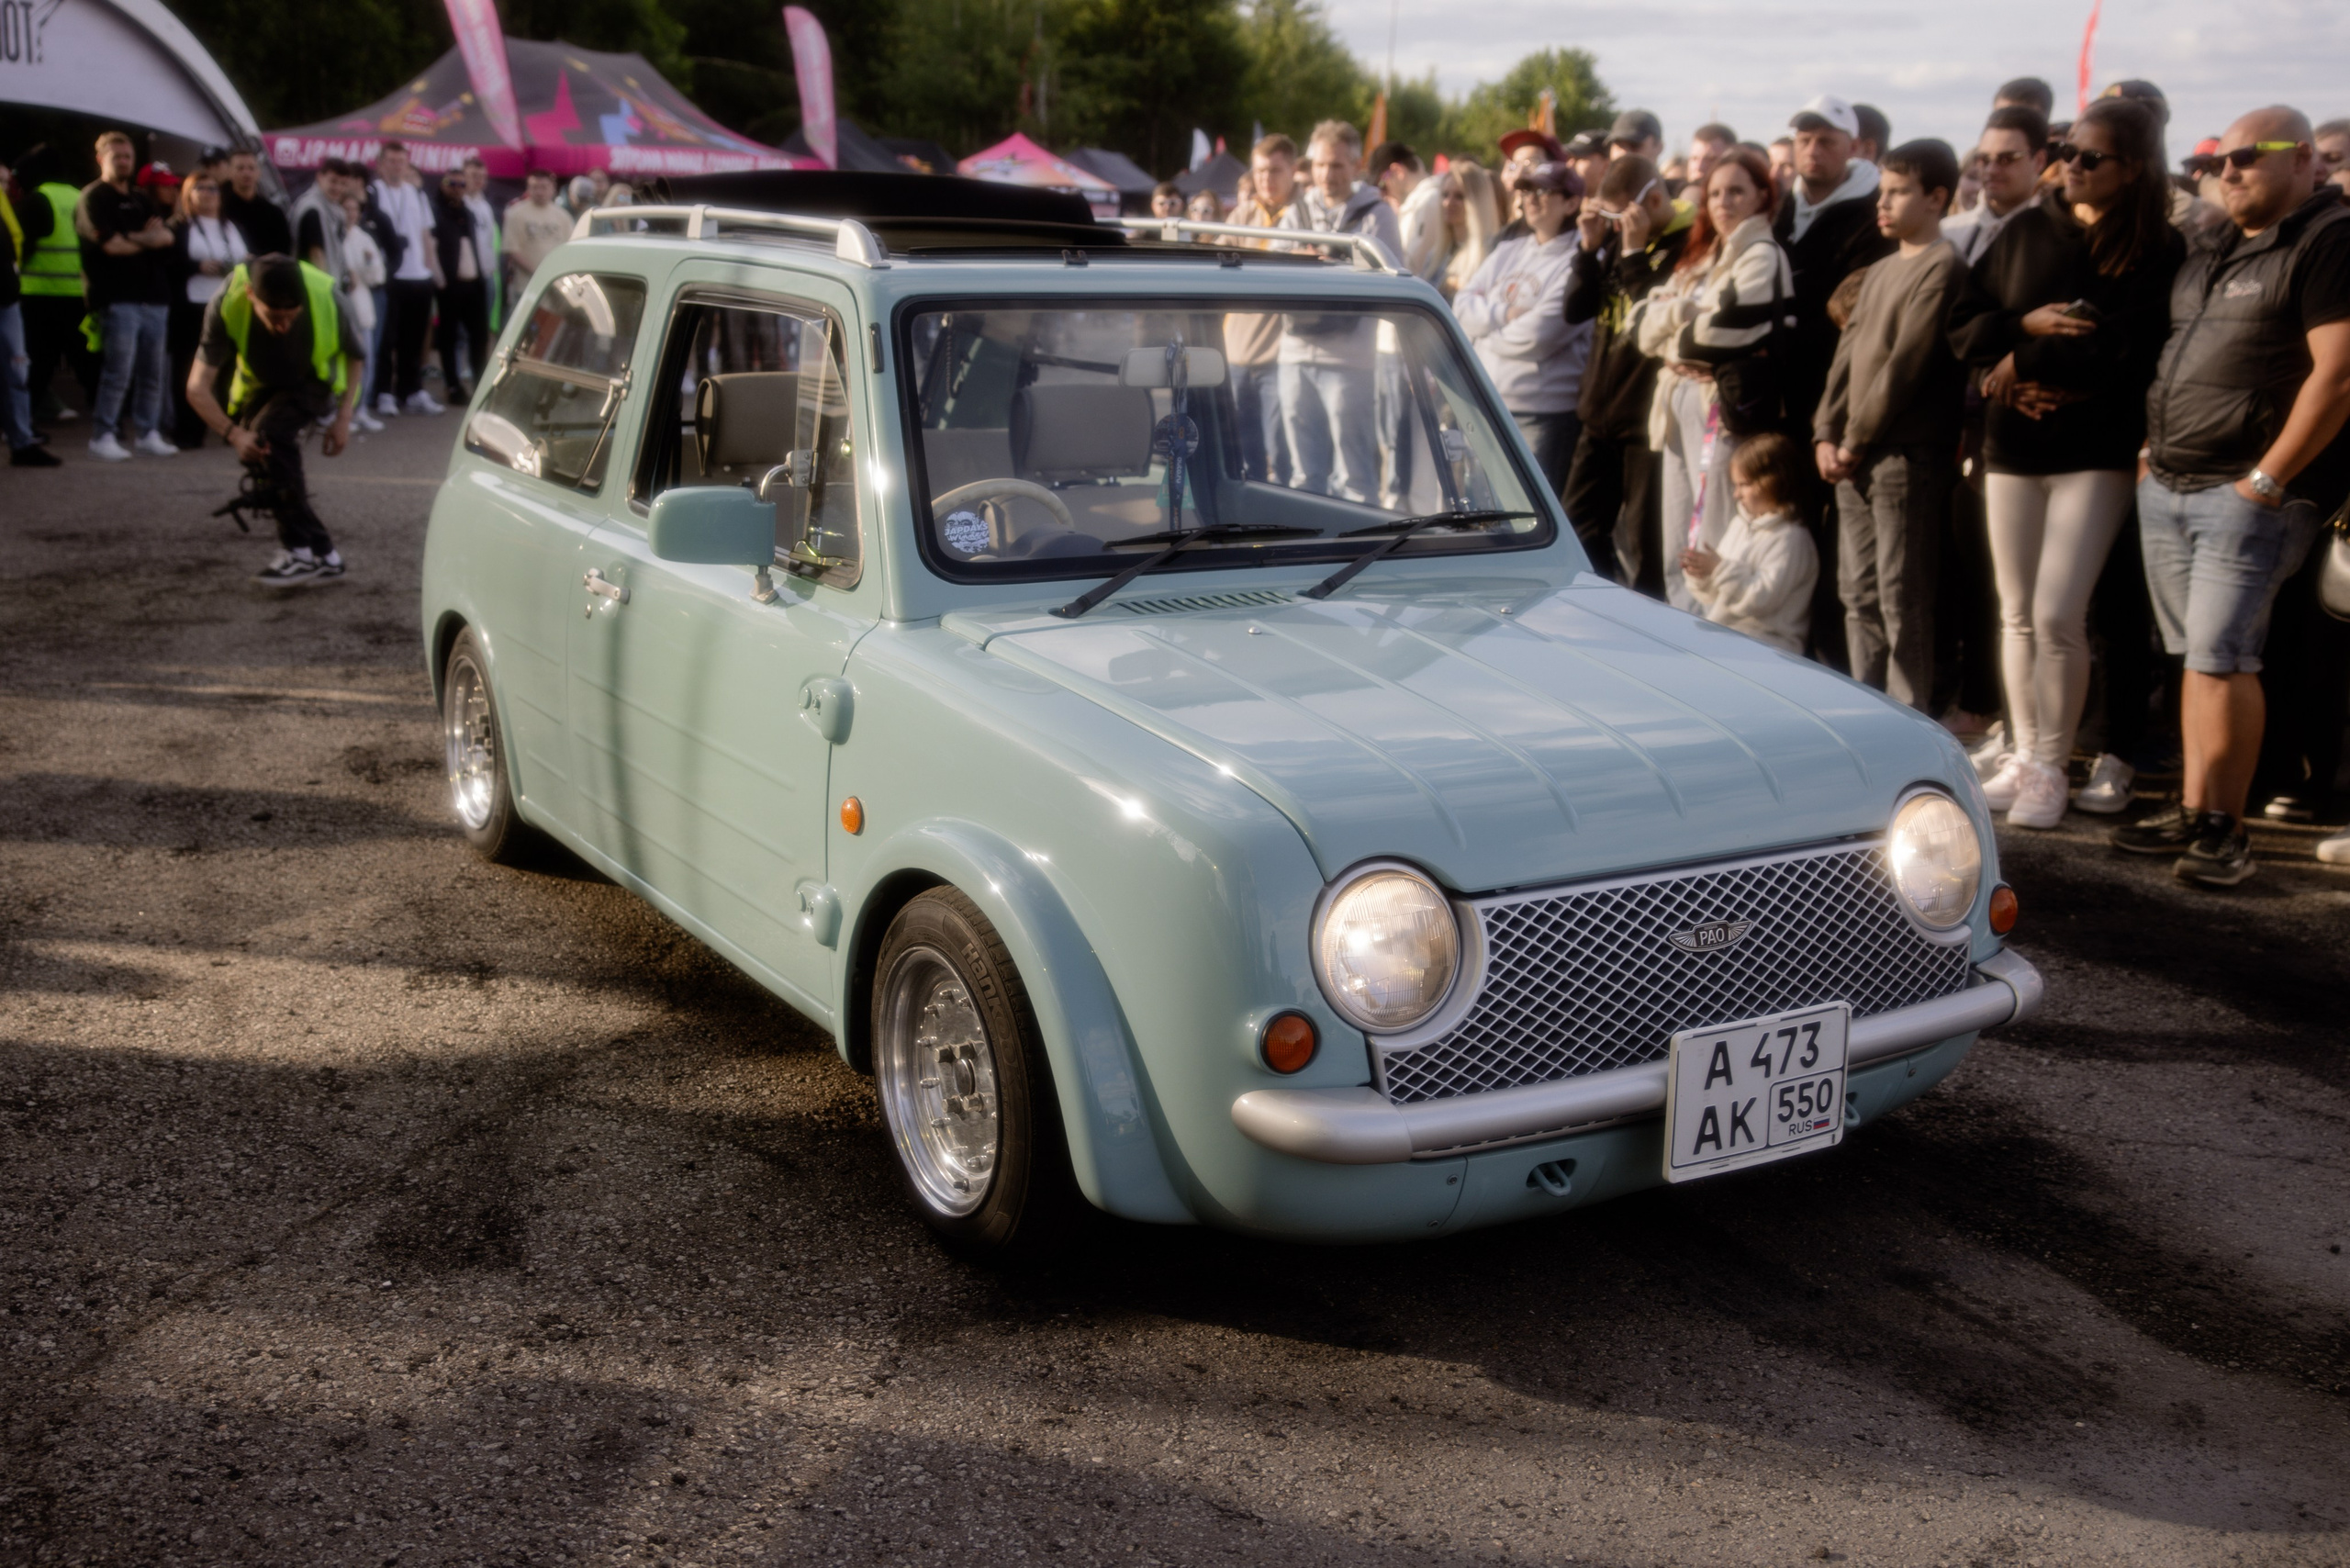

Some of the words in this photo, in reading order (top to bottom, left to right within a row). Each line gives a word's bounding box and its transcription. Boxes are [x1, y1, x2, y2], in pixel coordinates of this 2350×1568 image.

[945, 522, 989, 535] JAPDAYS
[1699, 927, 1725, 946] PAO
[1704, 1040, 1733, 1091] A
[1751, 1021, 1821, 1079] 473
[1777, 1078, 1833, 1123] 550
[1693, 1096, 1757, 1156] AK
[1788, 1119, 1813, 1137] RUS
